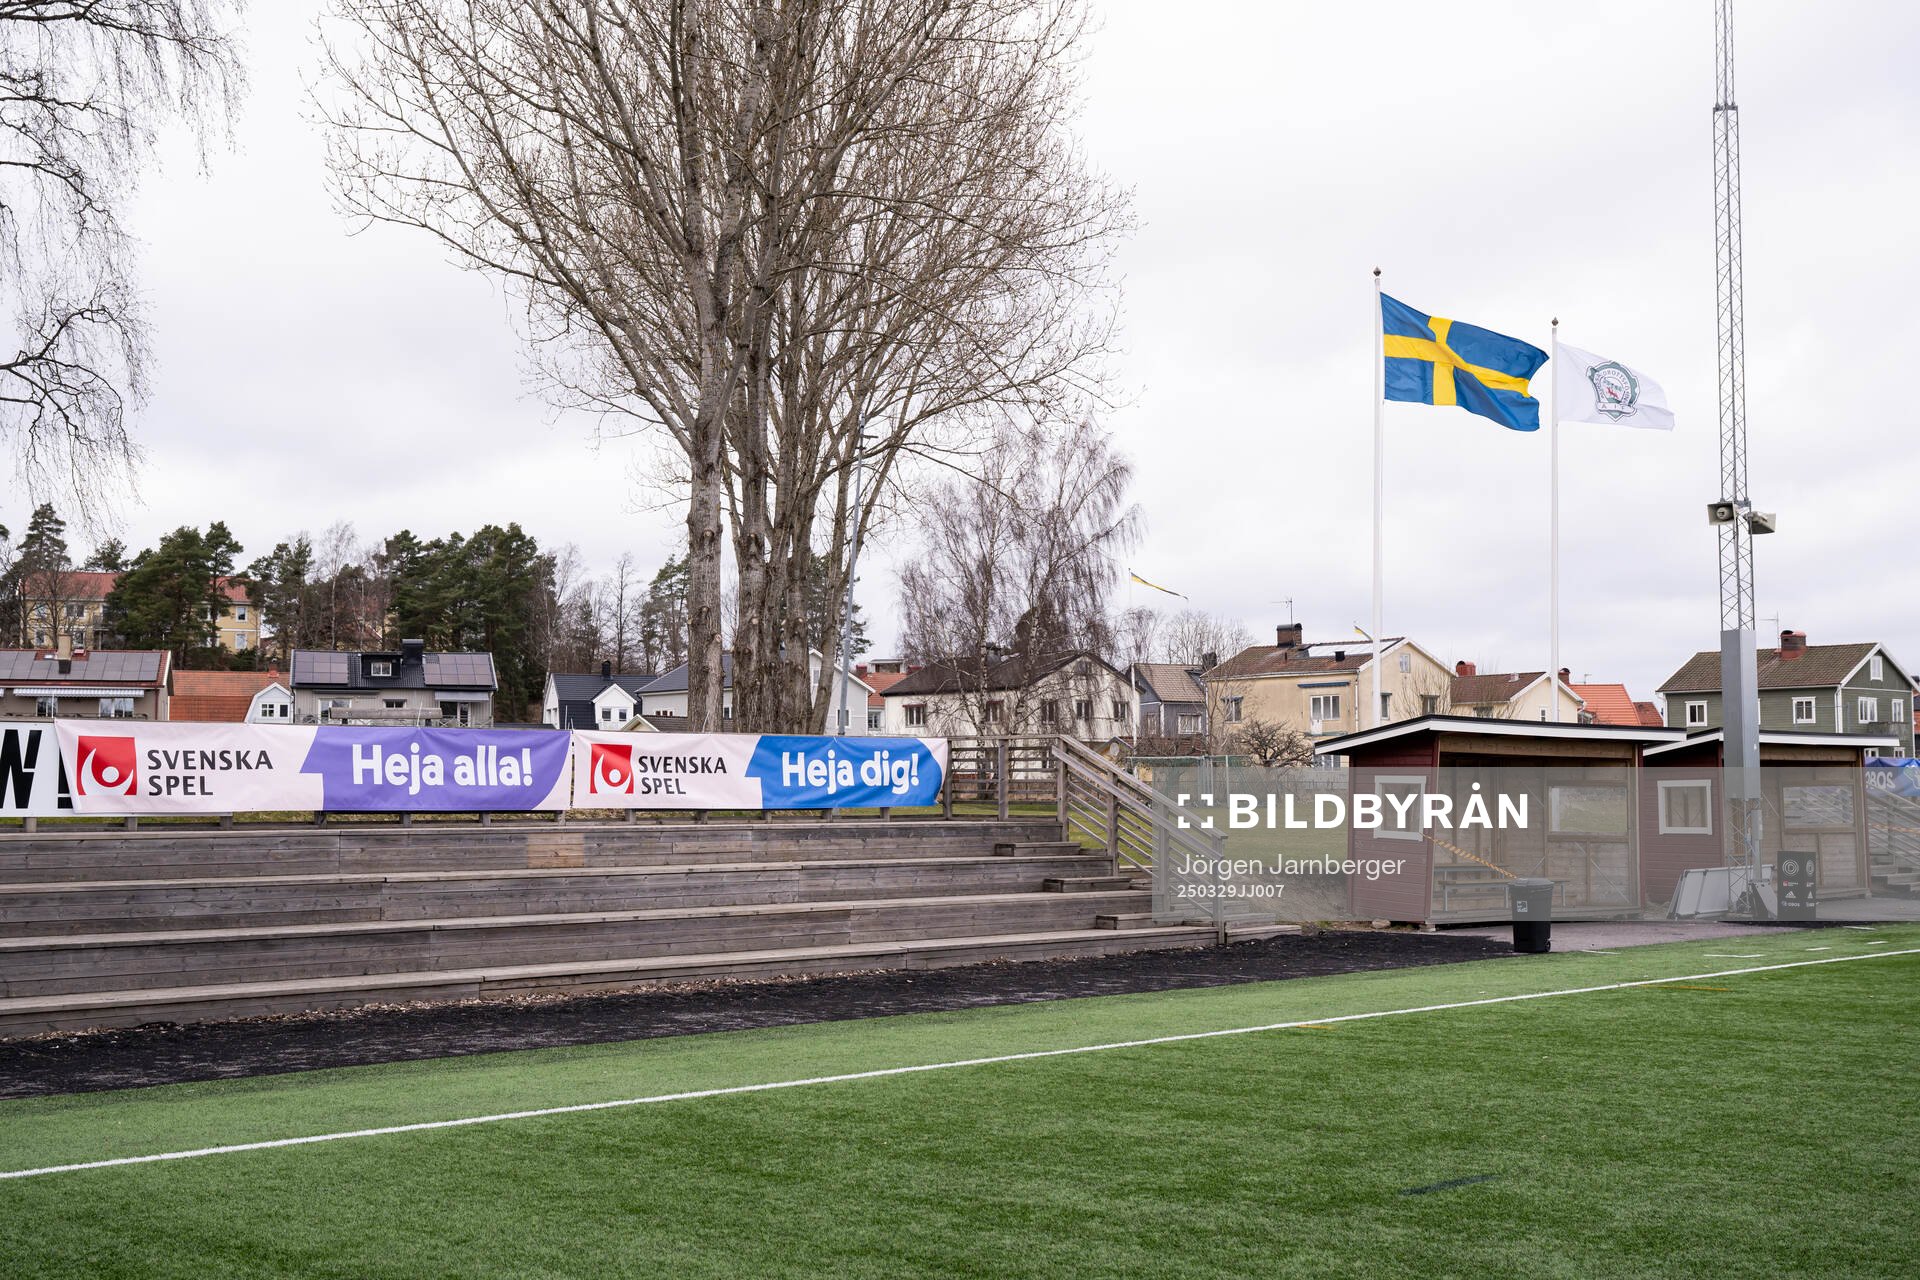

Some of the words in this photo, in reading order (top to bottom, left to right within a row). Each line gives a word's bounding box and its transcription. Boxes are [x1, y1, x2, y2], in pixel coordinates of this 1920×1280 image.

[148, 749, 273, 770] SVENSKA
[352, 742, 443, 795] Heja
[453, 744, 533, 787] alla!
[639, 755, 727, 774] SVENSKA
[782, 749, 855, 795] Heja
[860, 750, 919, 795] dig!
[148, 776, 213, 796] SPEL
[641, 777, 686, 795] SPEL
